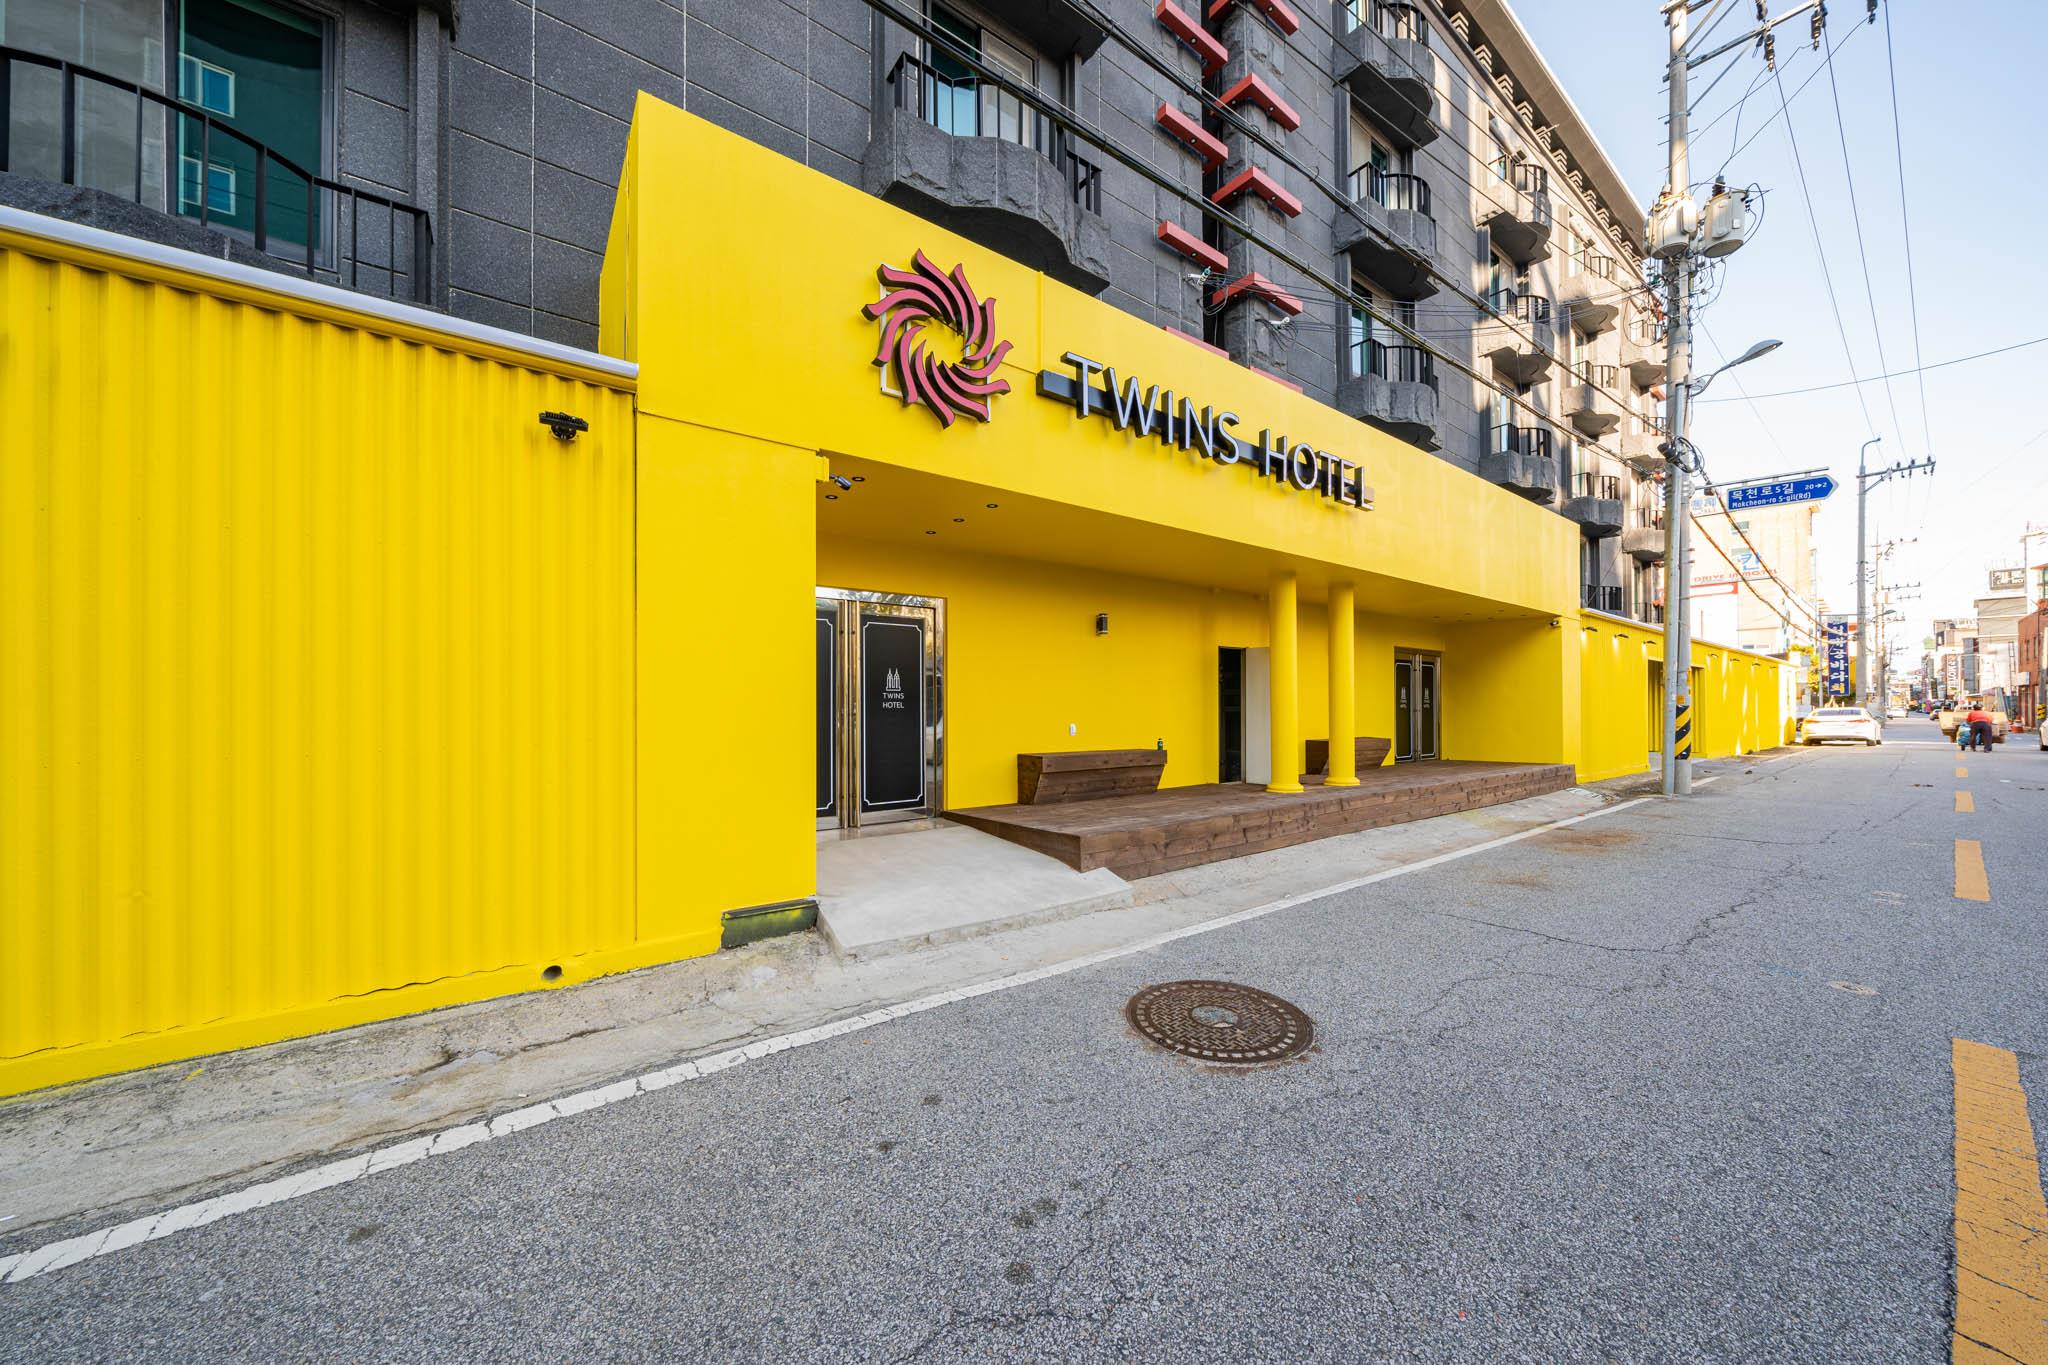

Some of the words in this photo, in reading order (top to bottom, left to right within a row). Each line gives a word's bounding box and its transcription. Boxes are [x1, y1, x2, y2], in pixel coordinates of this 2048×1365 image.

[1060, 352, 1240, 465] TWINS
[1259, 428, 1375, 511] HOTEL
[1732, 498, 1777, 509] Mokcheon-ro
[882, 692, 904, 700] TWINS
[882, 701, 904, 709] HOTEL
